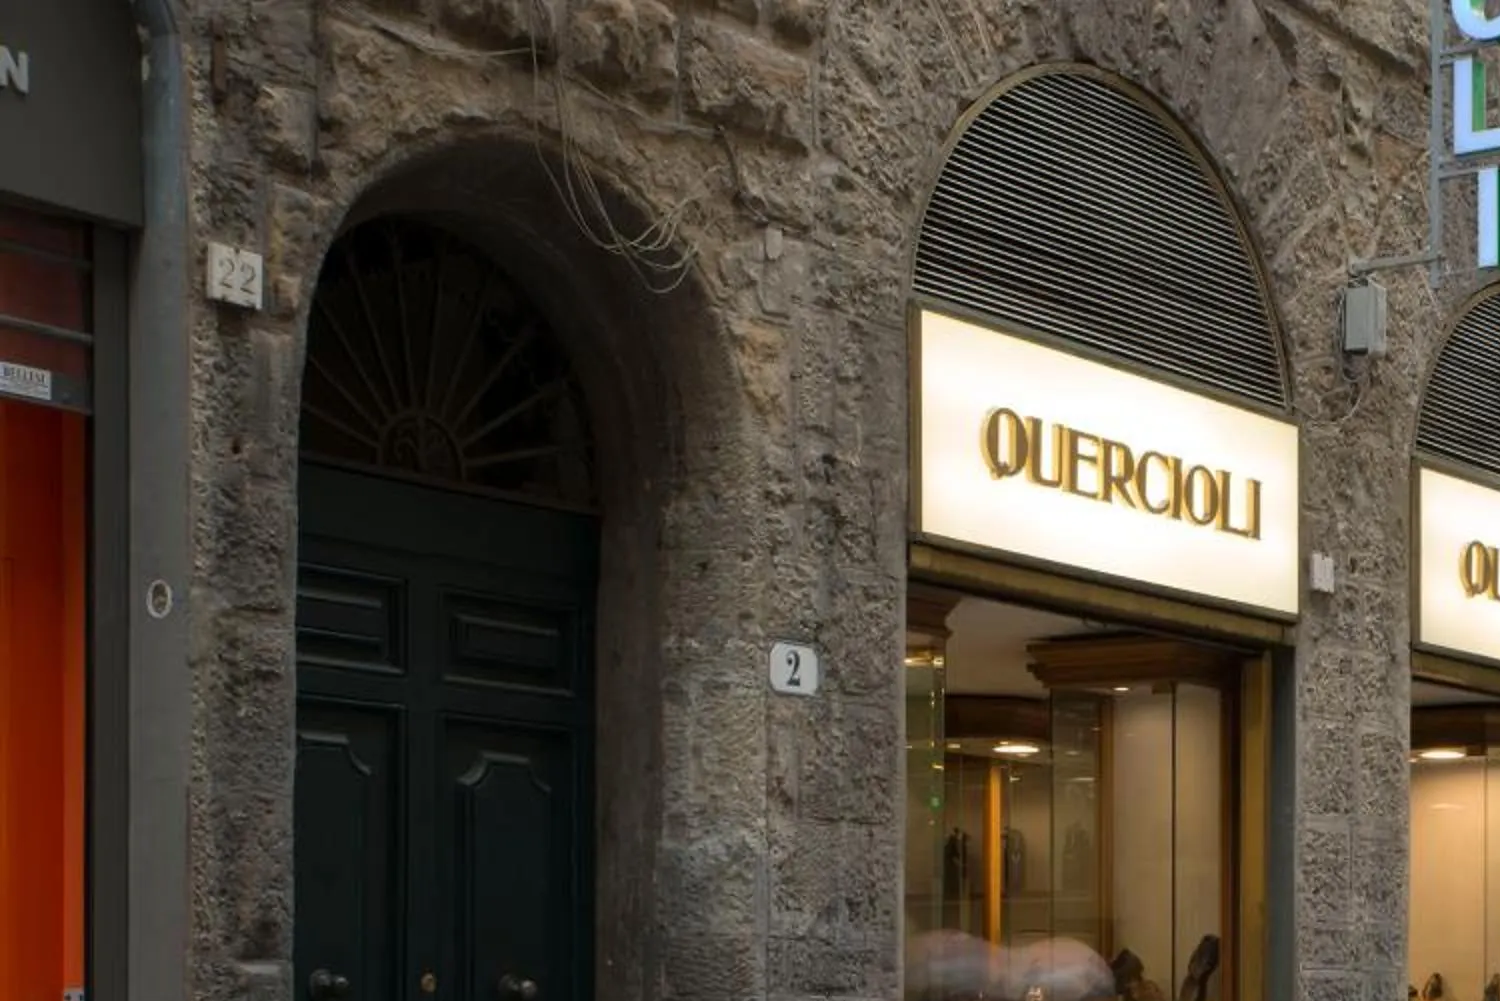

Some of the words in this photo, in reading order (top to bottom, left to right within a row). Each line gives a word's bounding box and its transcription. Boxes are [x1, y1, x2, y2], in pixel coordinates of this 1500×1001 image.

[219, 258, 256, 295] 22
[981, 406, 1261, 540] QUERCIOLI
[785, 649, 801, 687] 2
